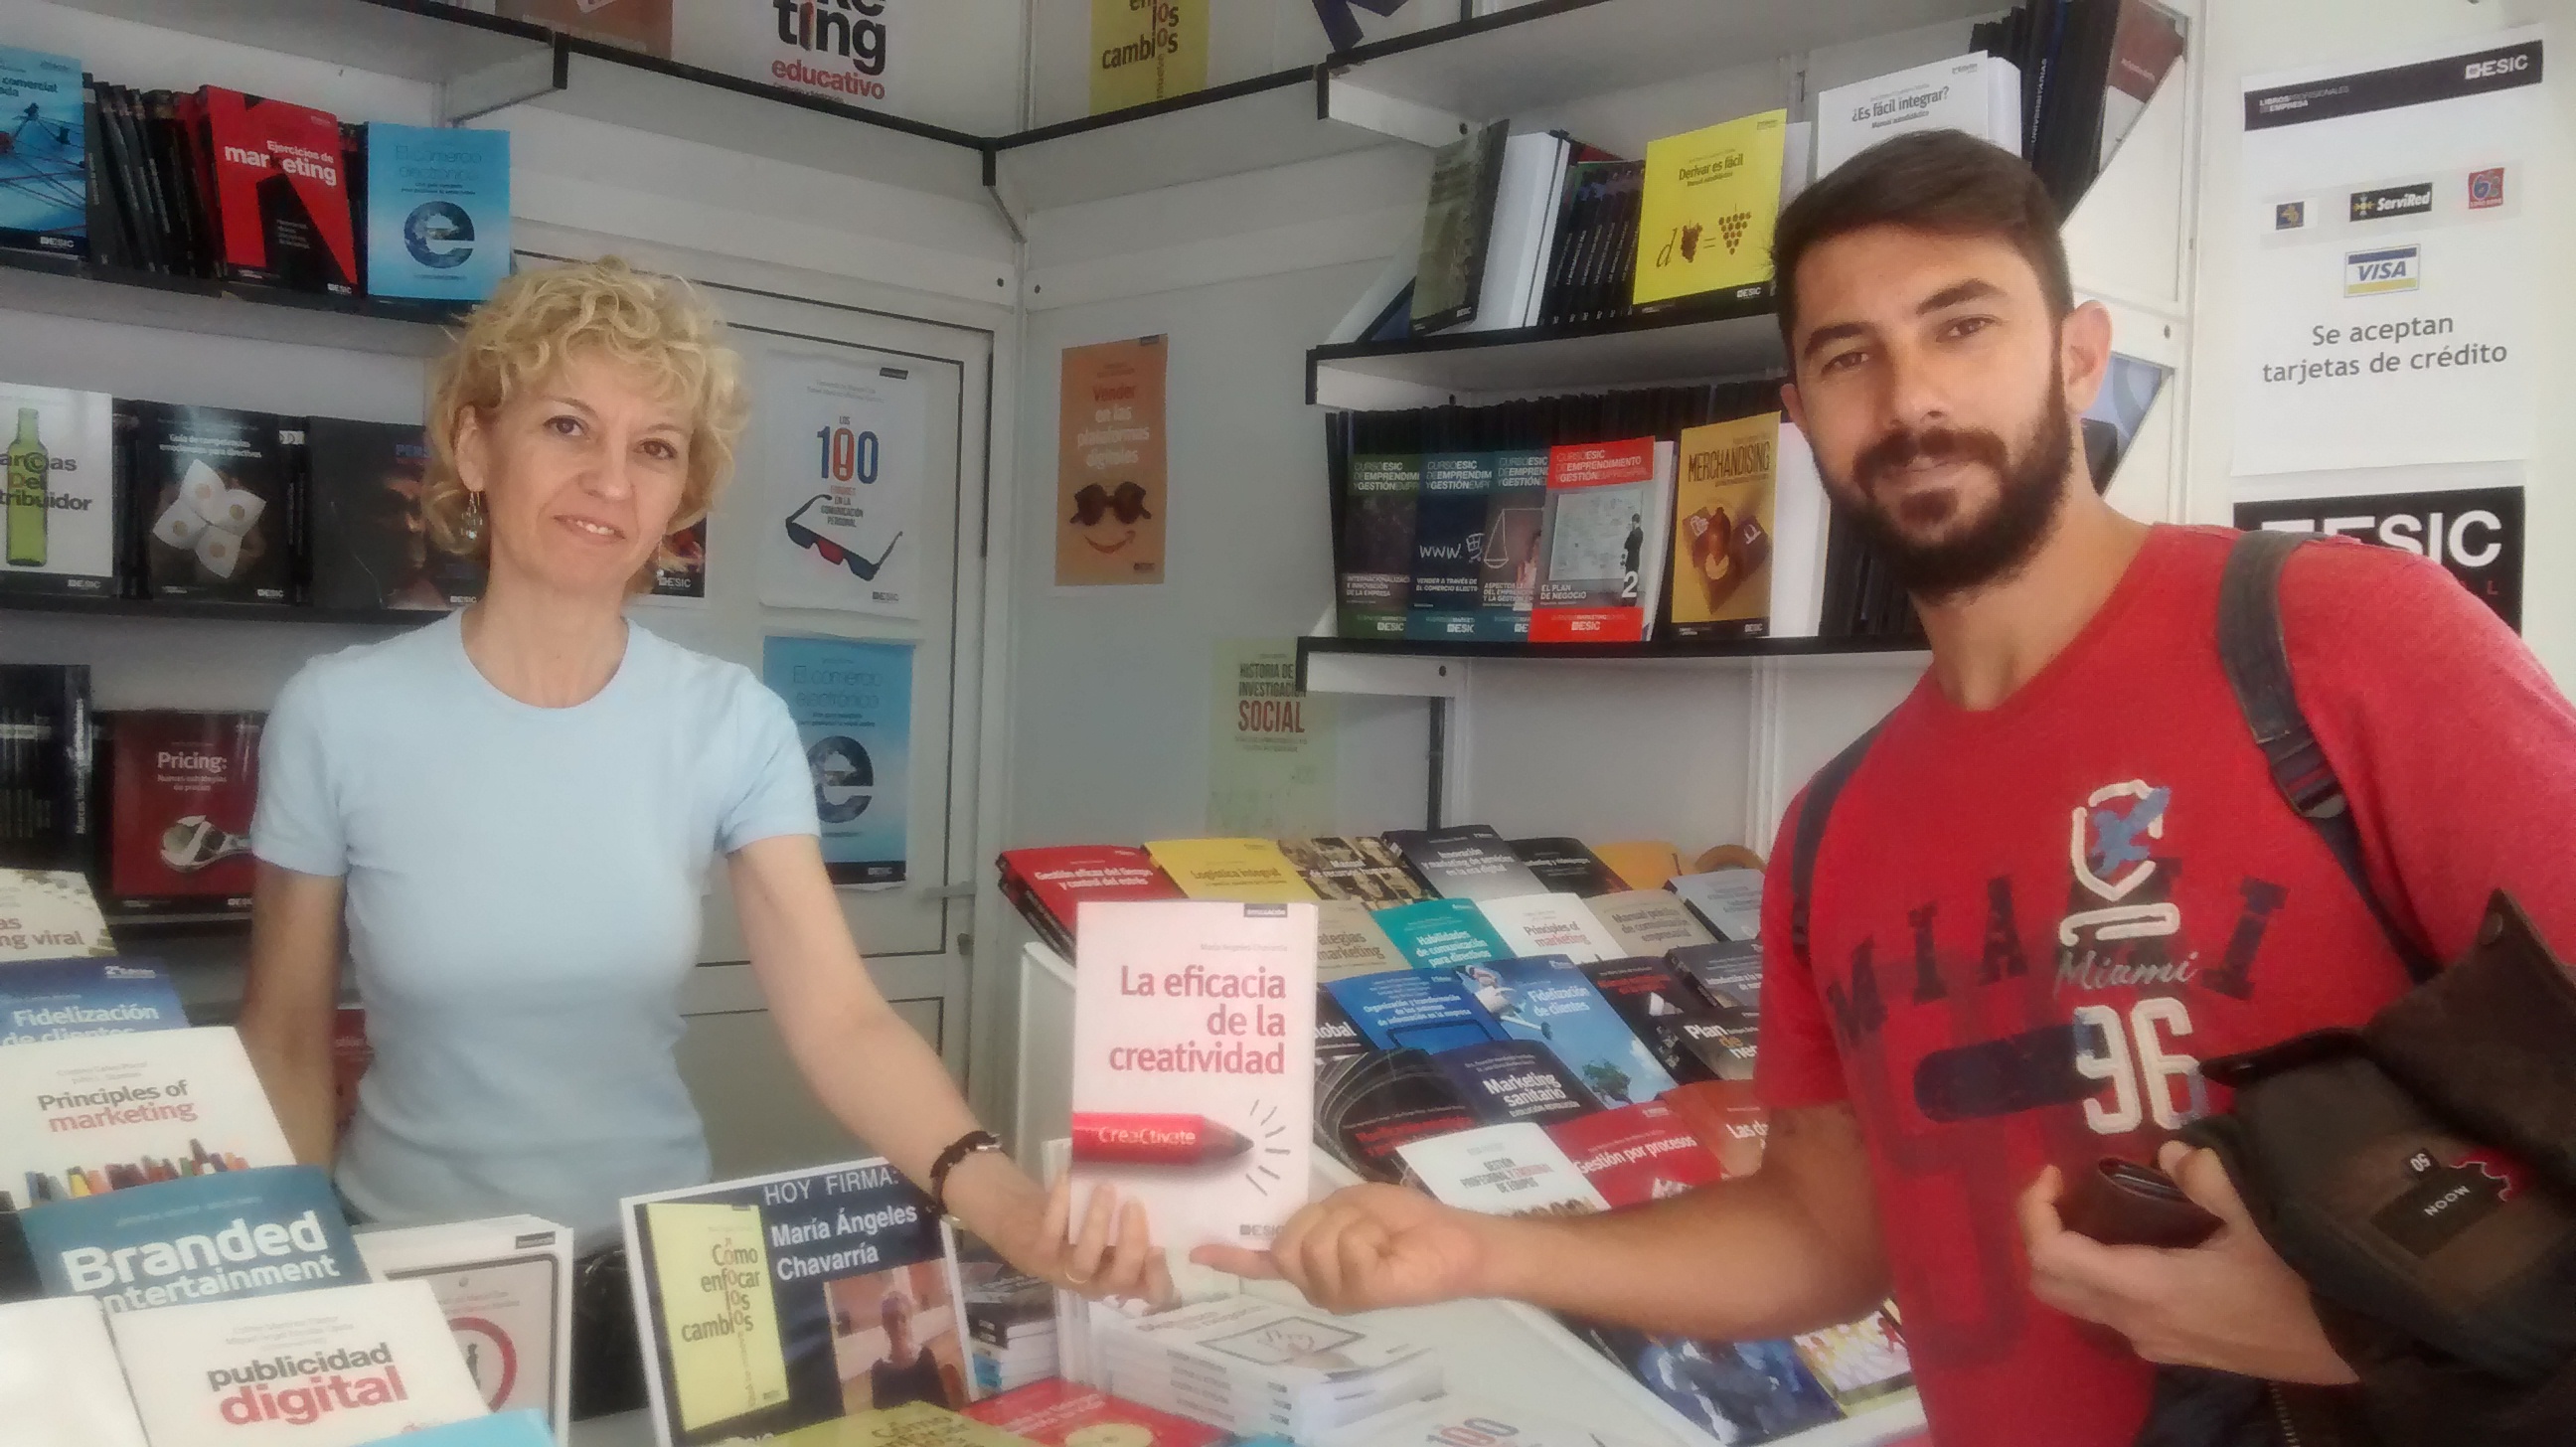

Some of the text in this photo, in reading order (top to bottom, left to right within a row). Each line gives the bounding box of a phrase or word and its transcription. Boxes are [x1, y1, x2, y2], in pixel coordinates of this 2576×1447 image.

[1102, 28, 1179, 70] cambios
[2483, 53, 2529, 77] ESIC
[771, 59, 886, 99] educativo
[1873, 97, 1896, 117] fácil
[1898, 84, 1950, 109] integrar?
[266, 140, 334, 164] Ejercicios de
[1679, 153, 1744, 181] Derivar es fácil
[2376, 191, 2431, 212] ServiRed
[2357, 260, 2407, 281] VISA
[2312, 317, 2454, 346] Se aceptan
[2262, 343, 2507, 385] tarjetas de crédito
[839, 415, 851, 425] LOS
[816, 425, 880, 485] 100
[1689, 442, 1771, 483] MERCHANDISING
[1540, 591, 1587, 600] DE NEGOCIO
[1621, 570, 1639, 598] 2
[1240, 663, 1295, 679] HISTORIA DE
[1238, 700, 1305, 733] SOCIAL
[157, 751, 228, 773] Pricing:
[1035, 869, 1073, 881] Gestión
[1330, 859, 1366, 869] Manual
[1524, 920, 1580, 936] Principles of
[1612, 909, 1648, 923] Manual
[1621, 924, 1635, 934] de
[32, 930, 85, 946] viral
[1416, 930, 1471, 945] Habilidades
[1416, 938, 1488, 957] de comunicación
[1534, 933, 1591, 947] marketing
[1317, 946, 1385, 960] marketing
[1428, 950, 1492, 968] para directivos
[1121, 965, 1287, 999] La eficacia
[2052, 949, 2199, 1001] Miami
[1528, 985, 1590, 1003] Fidelización
[12, 1004, 160, 1028] Fidelización
[1207, 1003, 1286, 1038] de la
[1533, 1001, 1590, 1017] de clientes
[1684, 1024, 1729, 1040] Plan
[1109, 1041, 1285, 1075] creatividad
[2074, 997, 2209, 1135] 96
[37, 1079, 189, 1112] Principles of
[1483, 1071, 1562, 1095] Marketing
[1503, 1086, 1567, 1107] sanitario
[49, 1102, 199, 1133] marketing
[1574, 1150, 1627, 1176] Gestión
[1624, 1145, 1647, 1164] por
[1646, 1135, 1697, 1159] procesos
[765, 1167, 900, 1206] HOY FIRMA:
[770, 1203, 918, 1248] María Ángeles
[61, 1209, 329, 1293] Branded
[776, 1241, 880, 1281] Chavarría
[102, 1254, 341, 1314] ntertainment
[701, 1268, 760, 1293] enfocar
[681, 1310, 754, 1344] cambios
[207, 1342, 395, 1392] publicidad
[219, 1365, 408, 1425] digital
